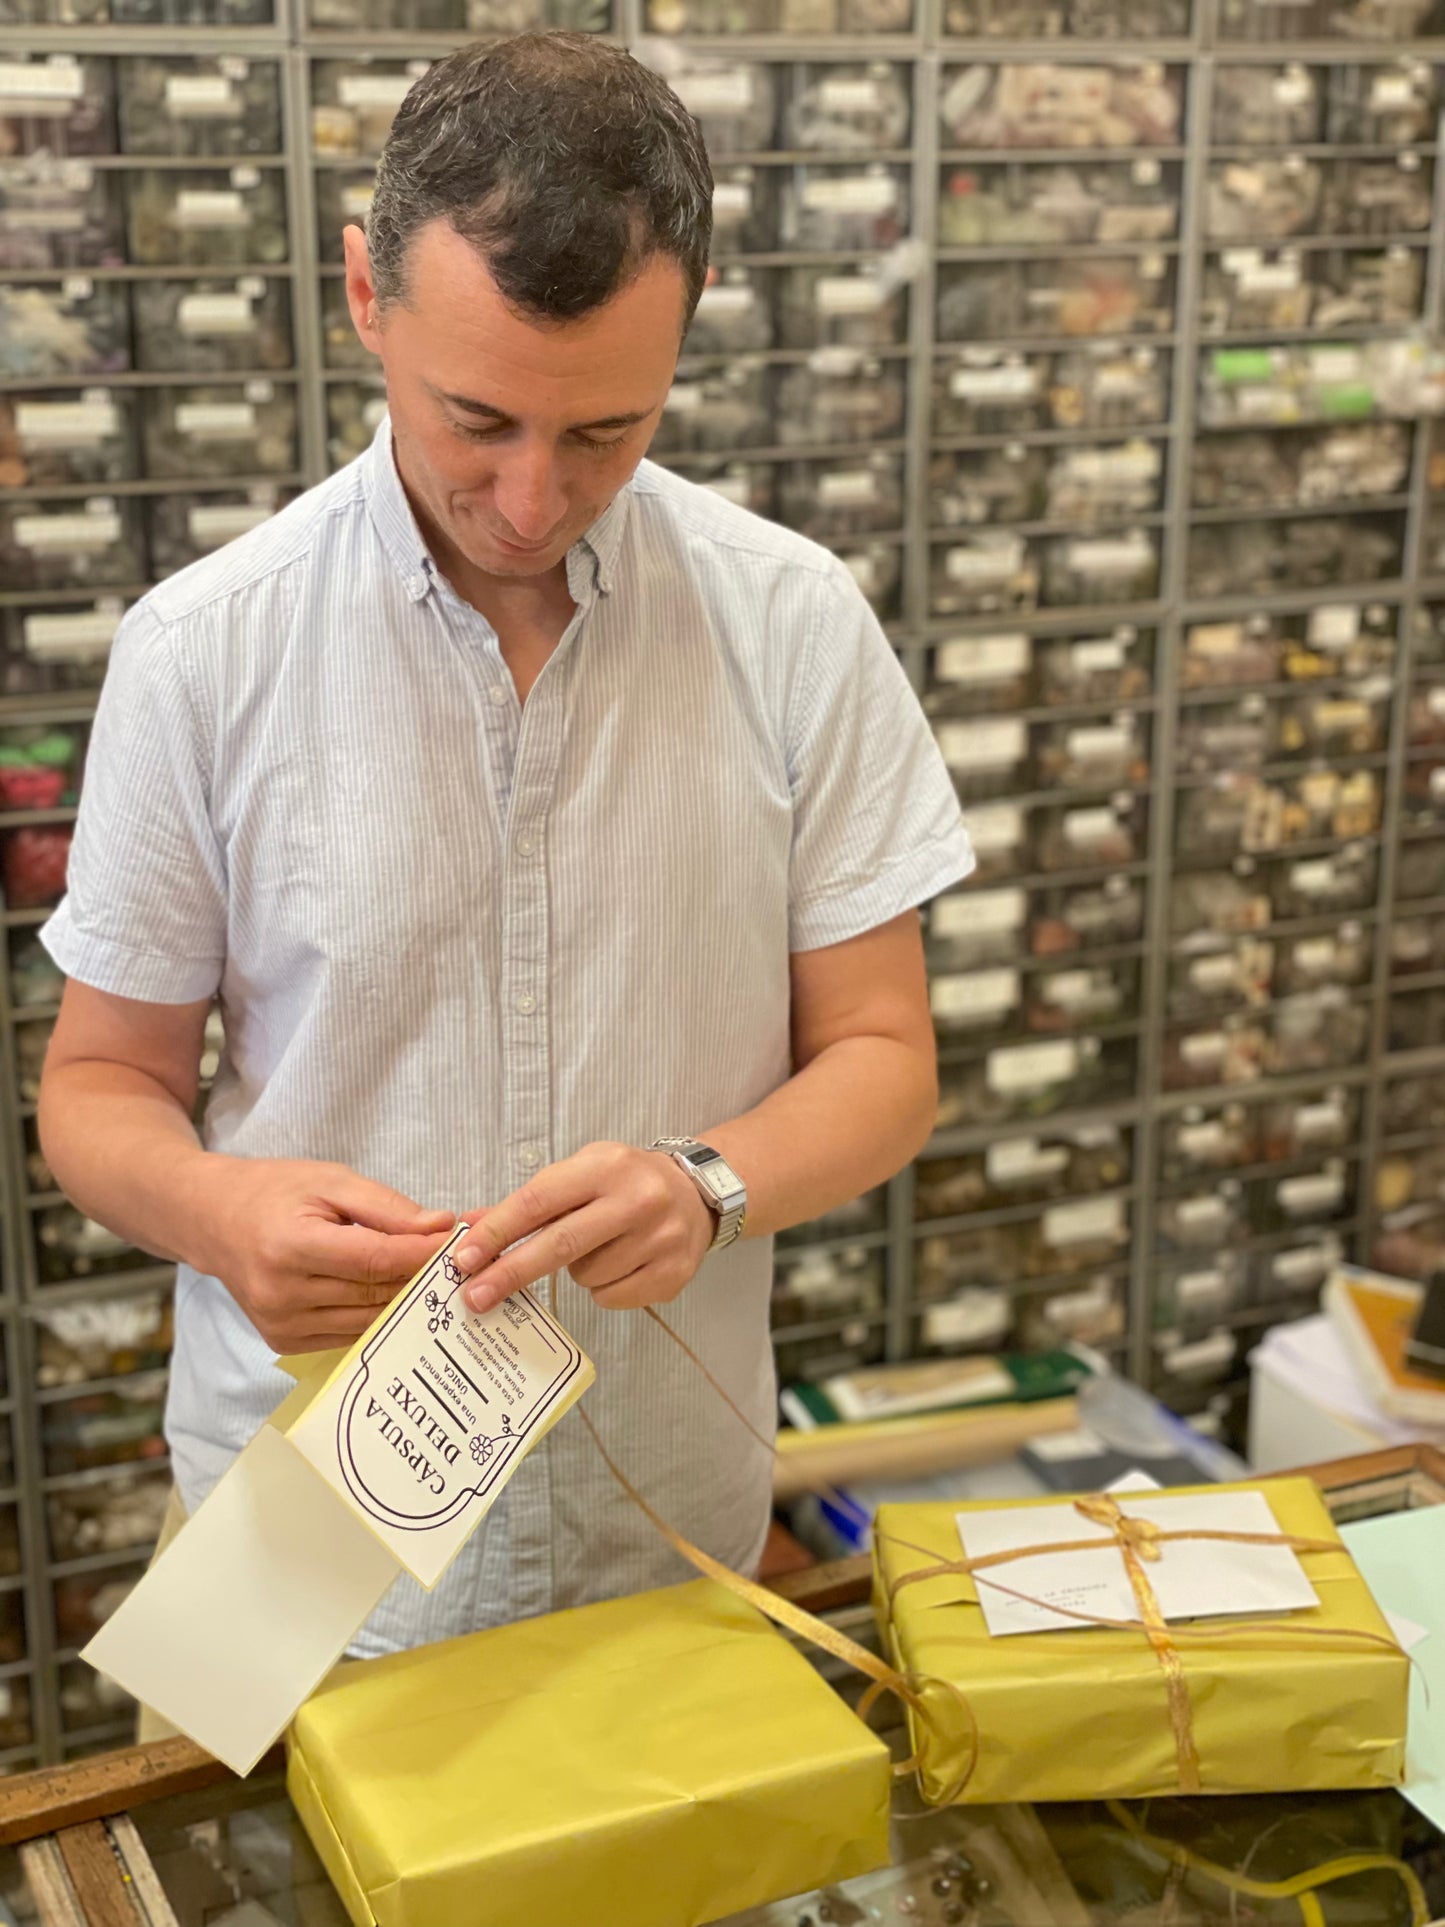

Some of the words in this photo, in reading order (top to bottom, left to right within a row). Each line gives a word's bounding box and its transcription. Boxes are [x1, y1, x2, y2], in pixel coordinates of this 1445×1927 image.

[461, 1321, 484, 1348] ponerte
[473, 1318, 481, 1328] su
[481, 1327, 496, 1344] para
[456, 1334, 488, 1371] experiencia
[495, 1327, 520, 1356] apertura
[482, 1347, 504, 1372] puedes
[495, 1343, 518, 1371] guantes
[420, 1355, 461, 1405] experiencia
[444, 1363, 468, 1395] ÚNICA
[487, 1371, 494, 1381] tu
[494, 1379, 502, 1389] es
[517, 1370, 526, 1384] los
[502, 1388, 515, 1406] Esta
[387, 1377, 462, 1466] DELUXE
[461, 1405, 476, 1425] Una
[366, 1397, 445, 1495] CÁPSULA
